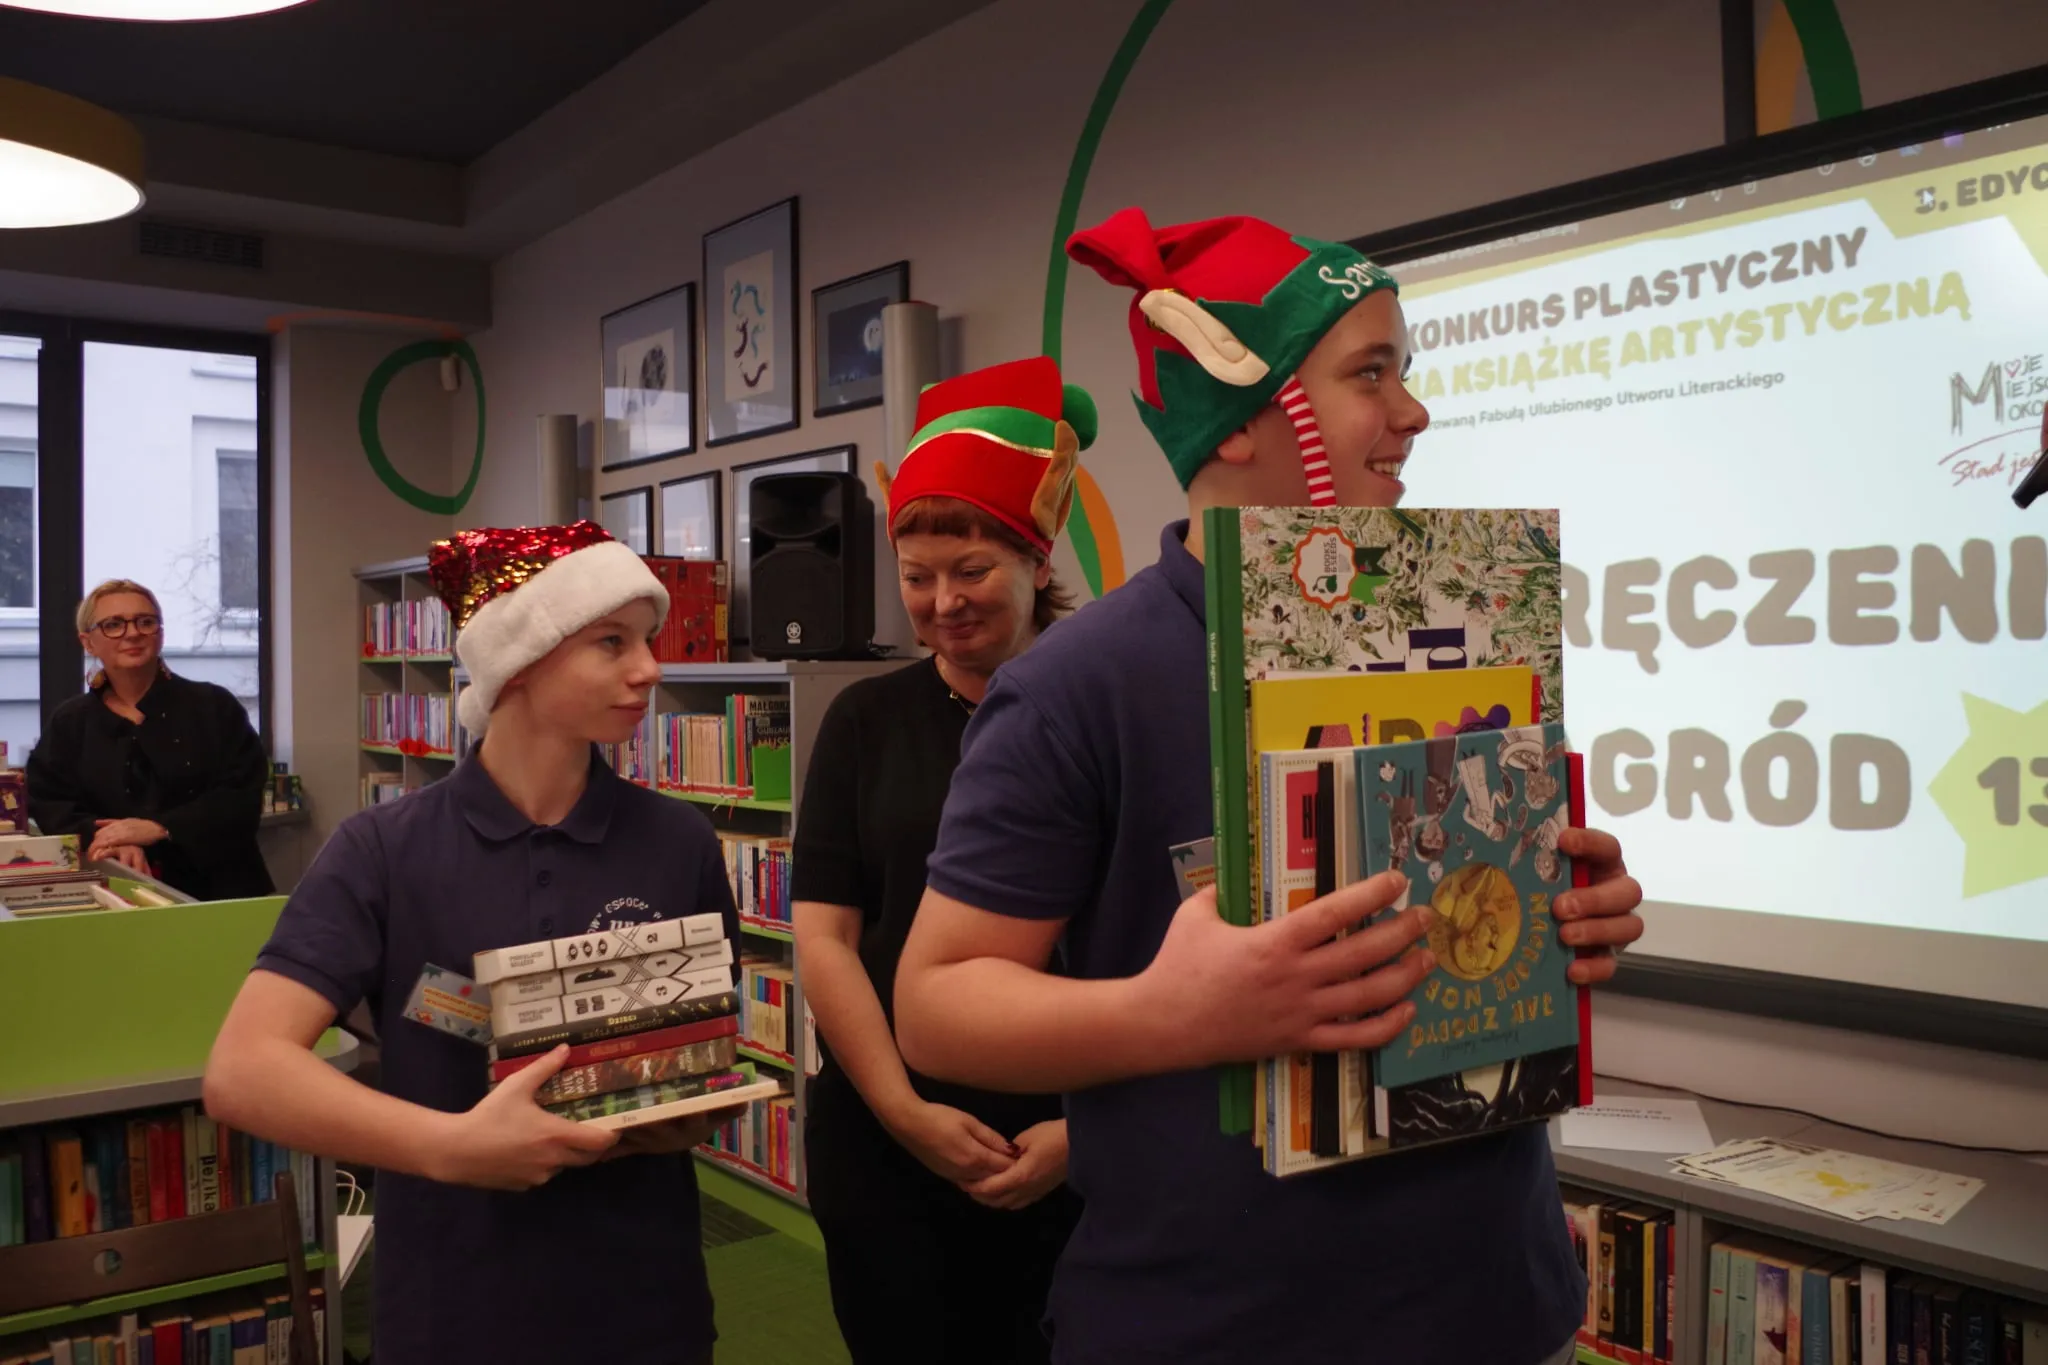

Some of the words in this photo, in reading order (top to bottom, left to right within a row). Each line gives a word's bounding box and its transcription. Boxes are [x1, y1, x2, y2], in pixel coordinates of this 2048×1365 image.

[1573, 227, 1868, 321] PLASTYCZNY
[1451, 336, 1612, 396] KSIĄŻKĘ
[1619, 271, 1972, 367] ARTYSTYCZNĄ
[1427, 414, 1476, 431] rowaną
[1479, 407, 1525, 424] Fabułą
[1528, 396, 1613, 417] Ulubionego
[1616, 388, 1674, 406] Utworu
[1679, 370, 1785, 397] Literackiego
[1562, 535, 2048, 675] RĘCZENI
[1590, 698, 1912, 831] GRÓD
[645, 931, 660, 943] 2
